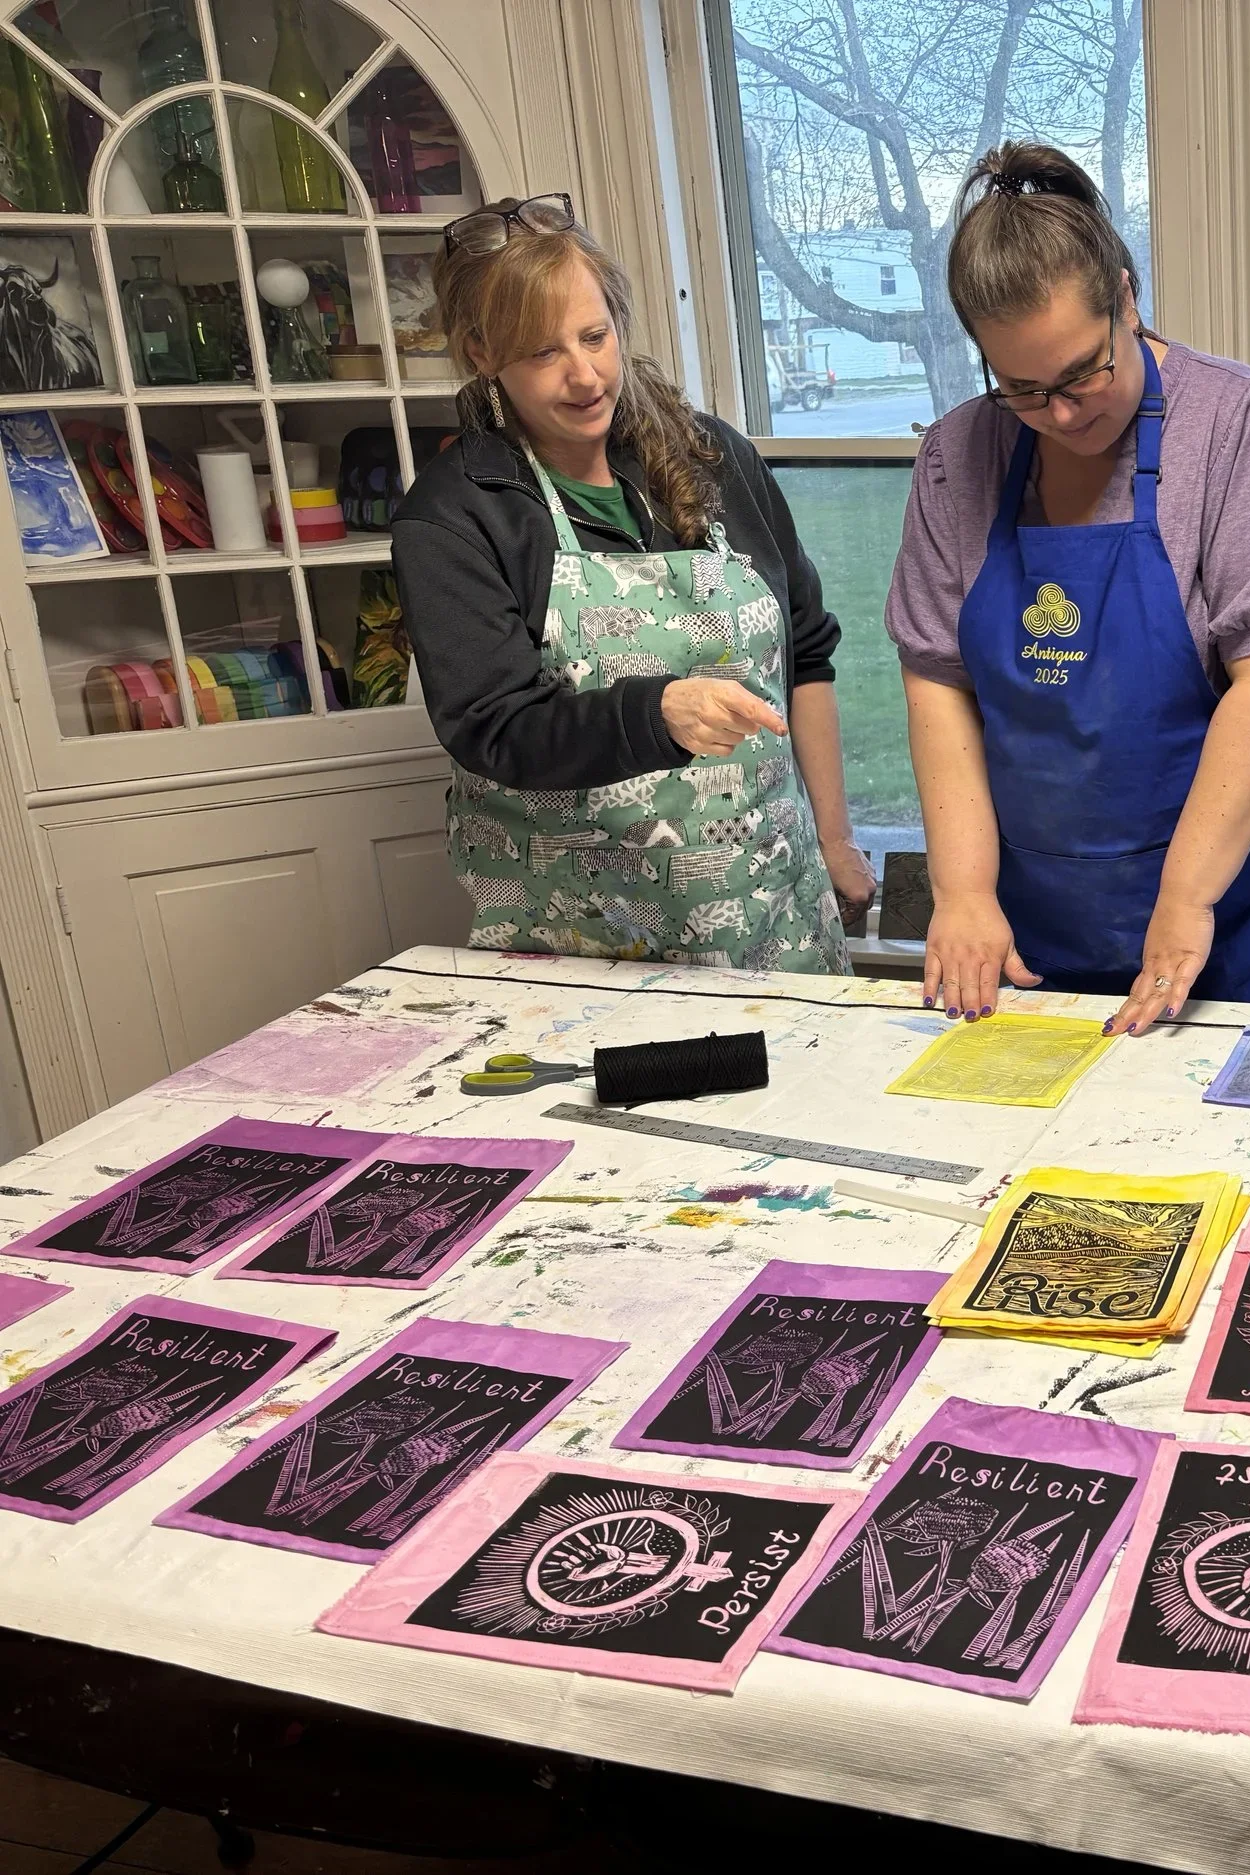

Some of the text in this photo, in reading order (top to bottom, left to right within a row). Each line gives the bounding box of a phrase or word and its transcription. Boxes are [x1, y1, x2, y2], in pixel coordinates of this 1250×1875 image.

[1021, 641, 1087, 666] Antigua
[1033, 667, 1069, 686] 2025
[187, 1144, 327, 1176] Resilient
[365, 1161, 510, 1186] Resilient
[750, 1295, 917, 1328] Resilient
[996, 1271, 1144, 1318] Rise
[111, 1317, 271, 1372] Resilient
[376, 1356, 544, 1404] Resilient
[918, 1445, 1107, 1506] Resilient
[697, 1529, 801, 1636] Persist
